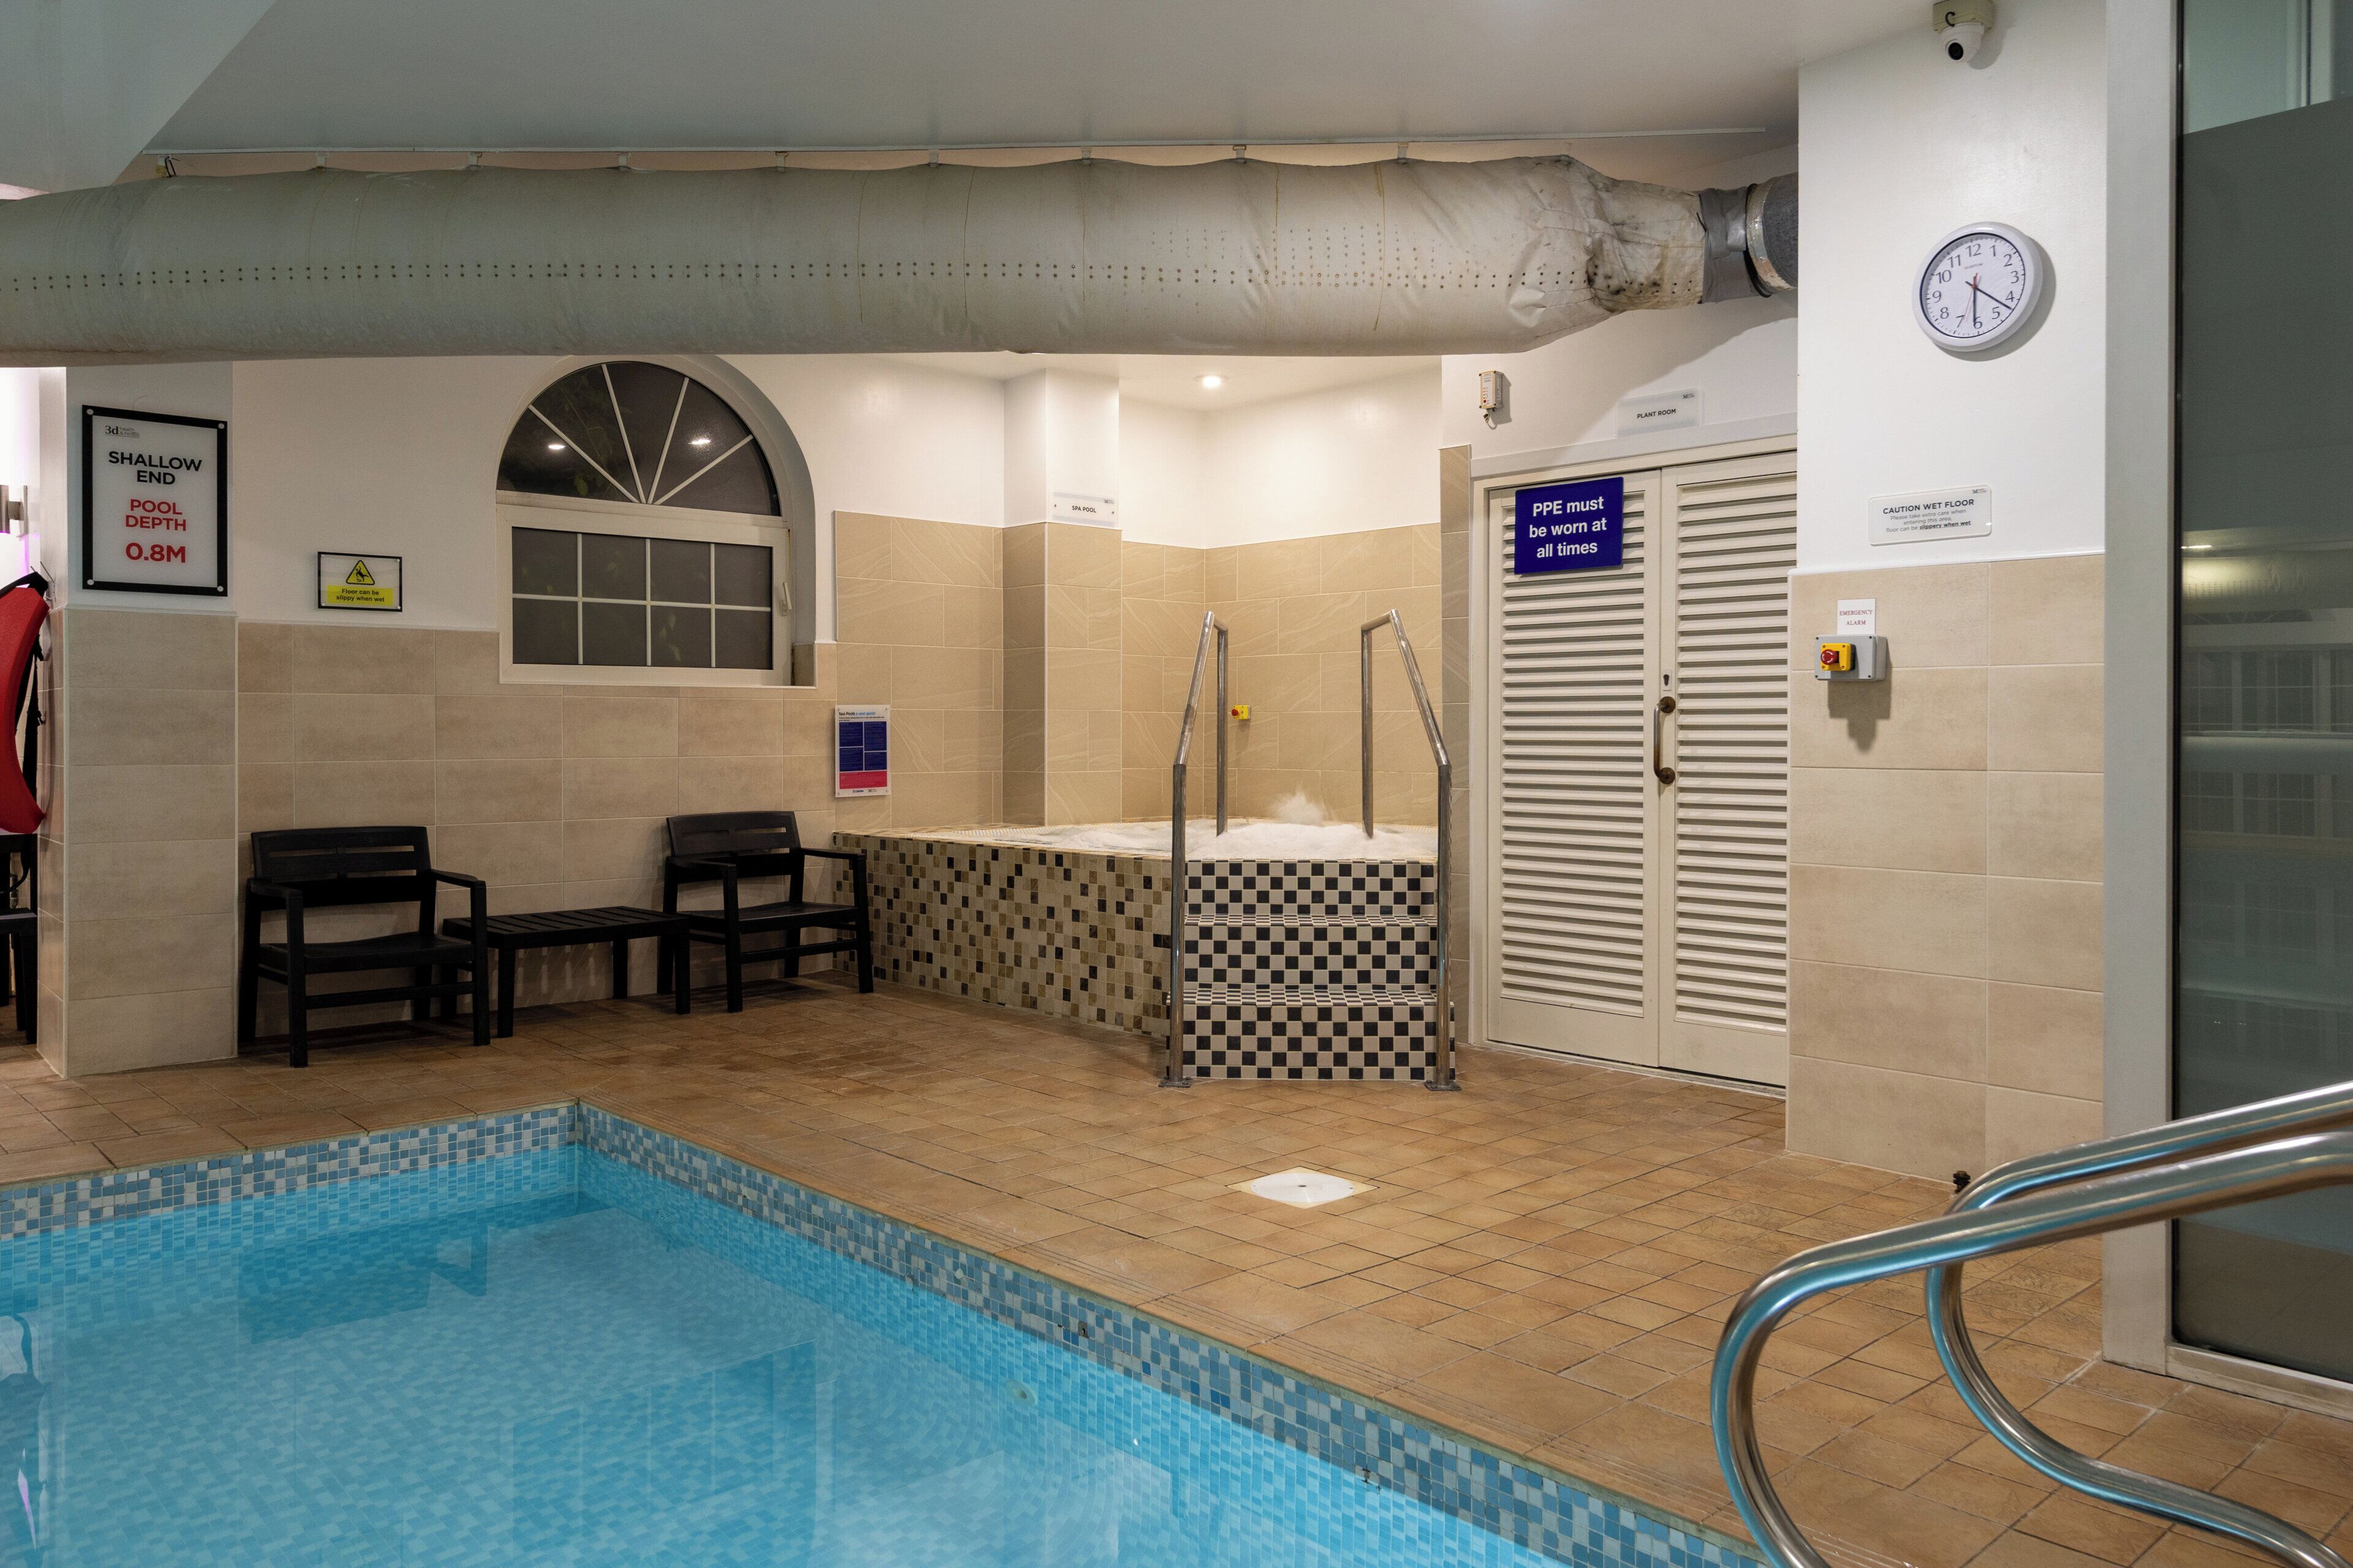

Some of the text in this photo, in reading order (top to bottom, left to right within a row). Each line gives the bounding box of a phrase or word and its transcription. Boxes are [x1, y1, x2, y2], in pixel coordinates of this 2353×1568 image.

[1966, 243, 1982, 257] 12
[1990, 245, 1996, 257] 1
[1947, 254, 1961, 268] 11
[2003, 254, 2012, 267] 2
[1936, 270, 1952, 284] 10
[2010, 270, 2020, 284] 3
[1932, 290, 1942, 303] 9
[2005, 290, 2015, 302] 4
[1940, 307, 1949, 319] 8
[1991, 306, 2000, 319] 5
[1956, 315, 1965, 328] 7
[1973, 316, 1983, 329] 6
[105, 425, 119, 435] 3d
[108, 451, 202, 472] SHALLOW
[137, 470, 176, 485] END
[130, 499, 183, 515] POOL
[1533, 496, 1604, 517] PPE must
[1883, 504, 1920, 514] CAUTION
[1944, 499, 1974, 508] FLOOR
[125, 515, 186, 531] DEPTH
[1529, 517, 1607, 538] be worn at
[125, 542, 186, 563] 0.8M
[1536, 542, 1598, 558] all times
